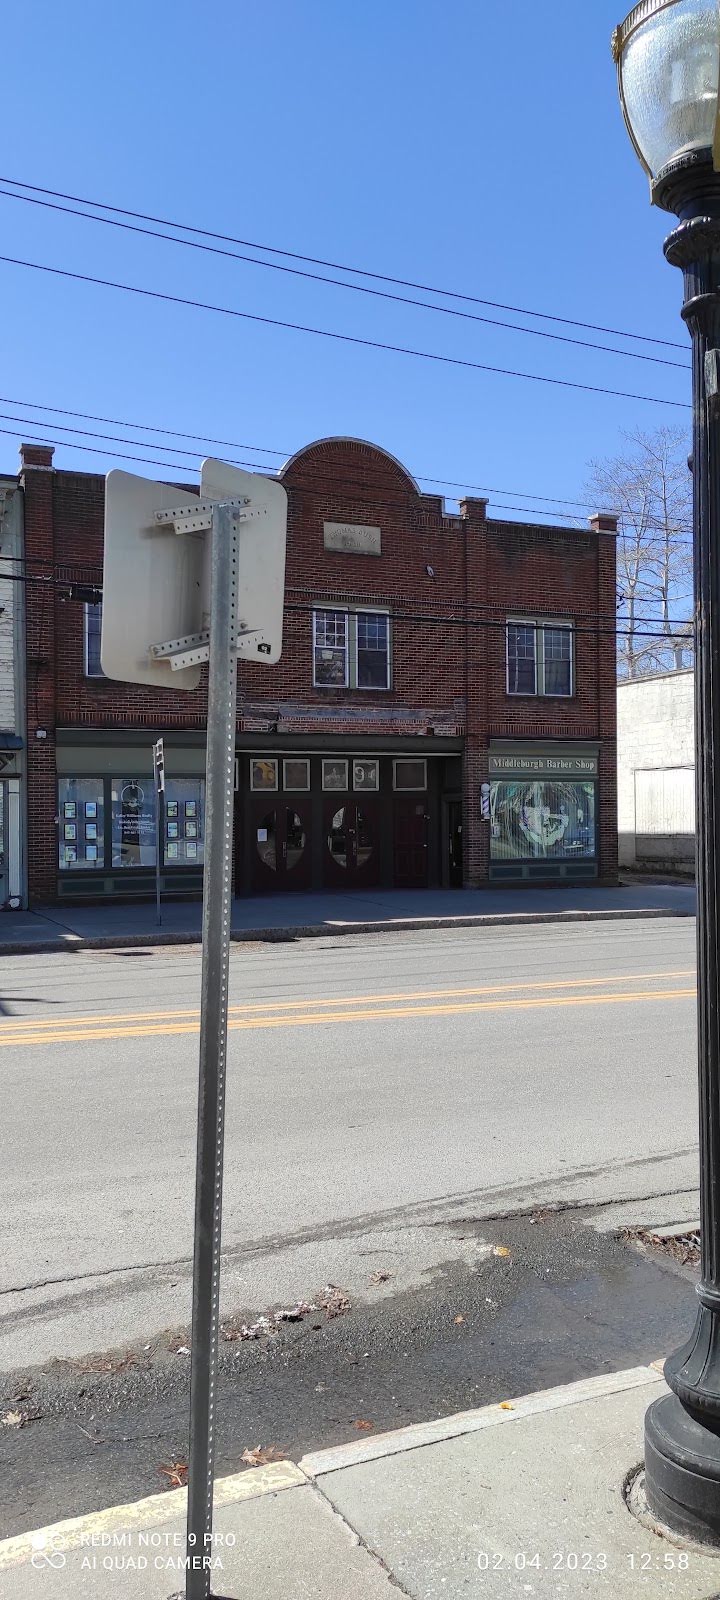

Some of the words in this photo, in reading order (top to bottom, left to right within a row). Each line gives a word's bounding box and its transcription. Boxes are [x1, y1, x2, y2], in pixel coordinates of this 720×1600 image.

[492, 758, 544, 769] Middleburgh
[546, 759, 573, 768] Barber
[575, 760, 595, 770] Shop
